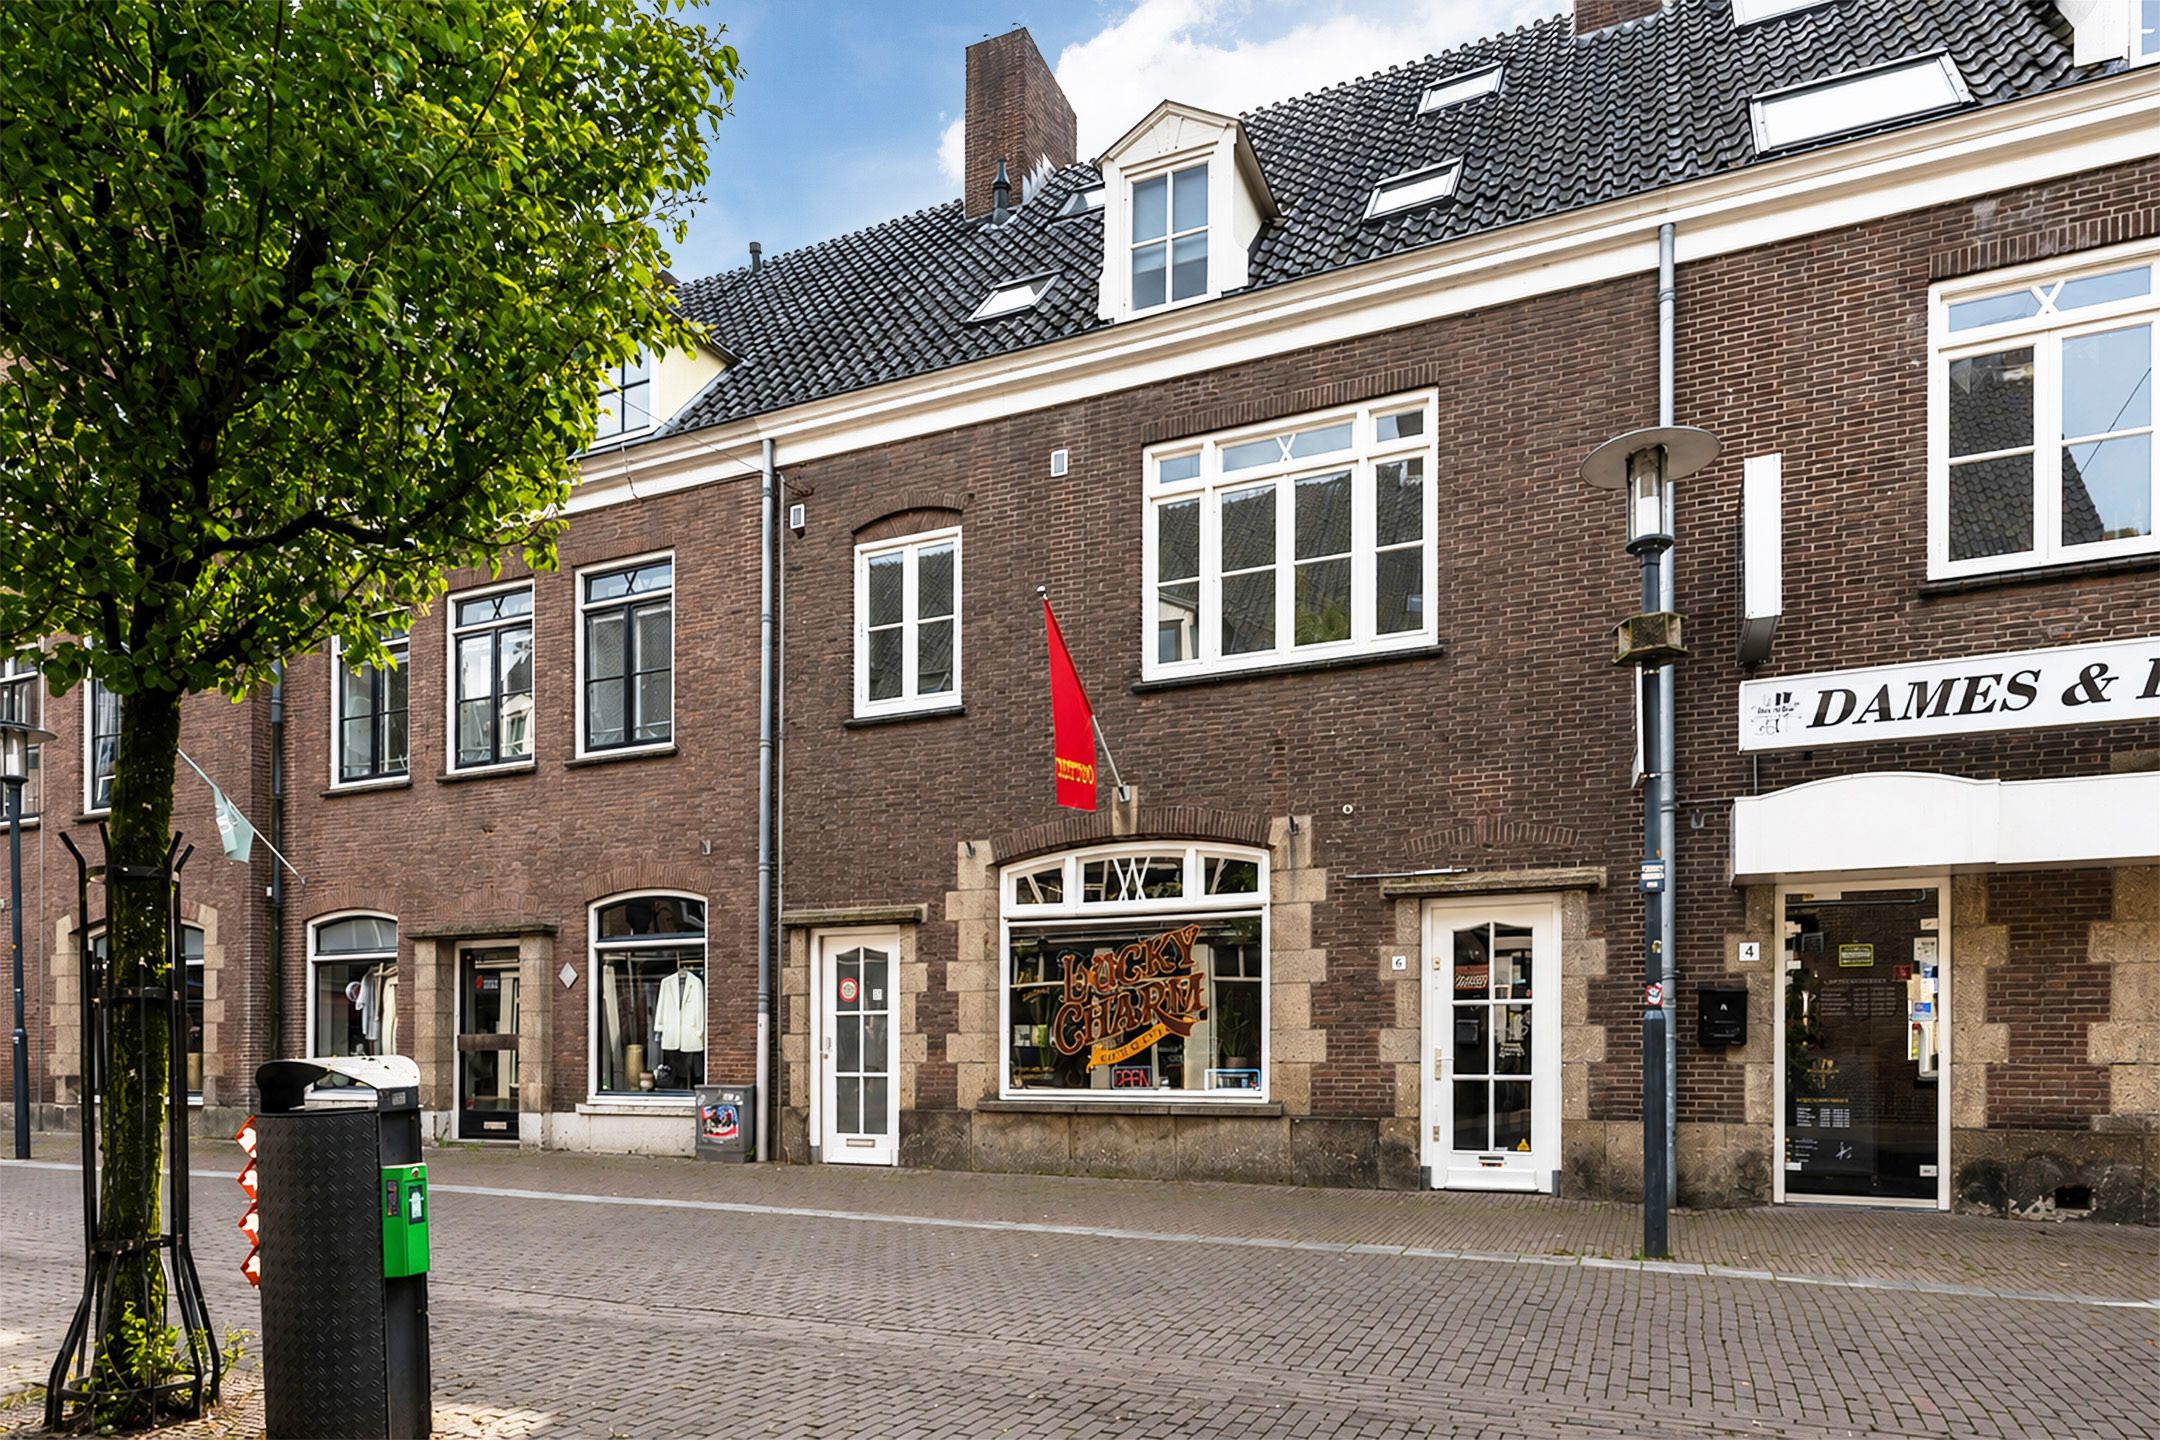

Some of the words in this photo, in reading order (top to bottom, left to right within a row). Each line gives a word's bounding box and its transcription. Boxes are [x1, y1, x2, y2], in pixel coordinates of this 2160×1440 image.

[1806, 669, 2041, 729] DAMES
[2061, 662, 2119, 707] &
[1061, 923, 1201, 1004] LUCKY
[1395, 958, 1403, 968] 6
[1744, 945, 1754, 957] 4
[1052, 972, 1208, 1056] CHARM
